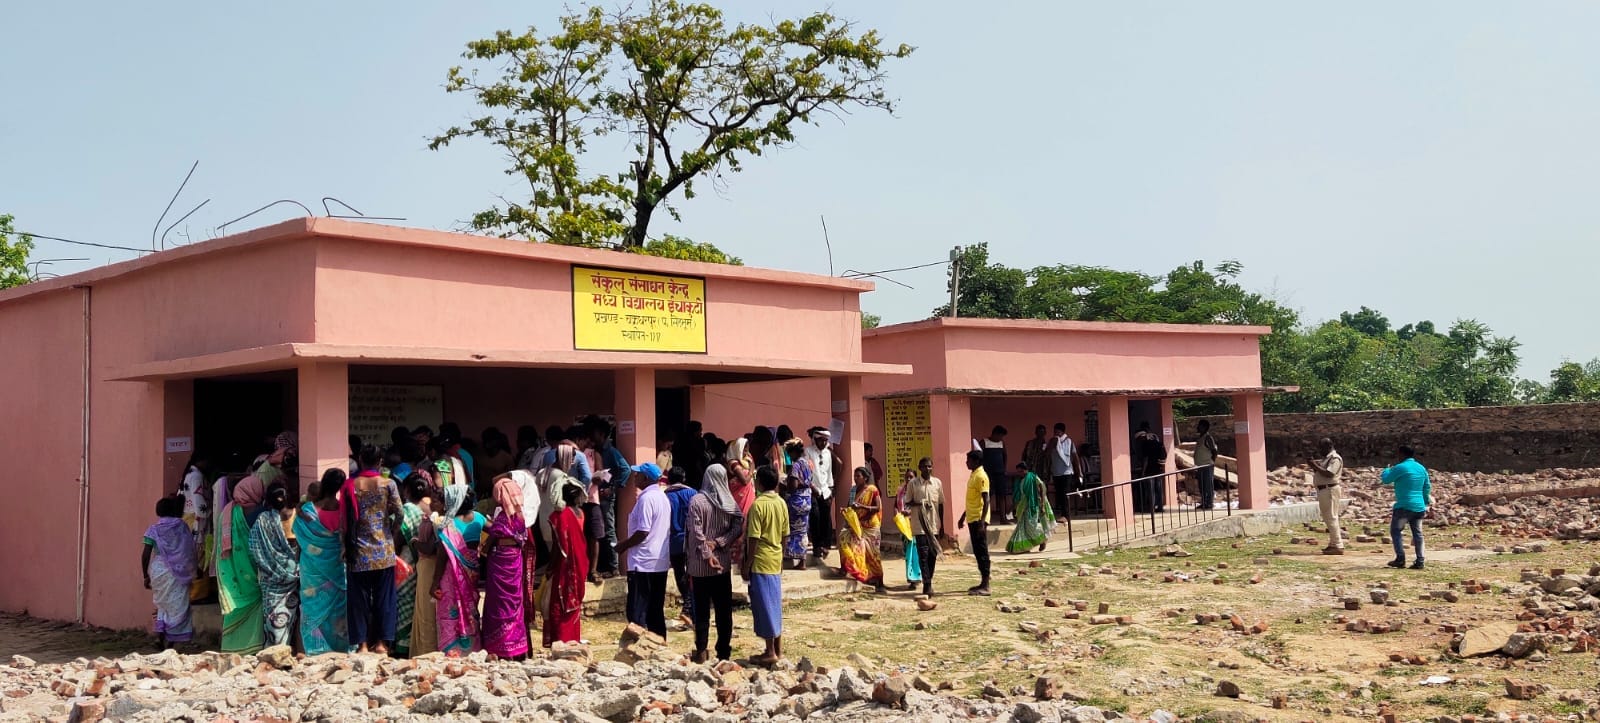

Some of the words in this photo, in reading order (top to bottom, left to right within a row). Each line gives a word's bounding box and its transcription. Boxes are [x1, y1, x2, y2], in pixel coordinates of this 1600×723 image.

[667, 279, 689, 298] केन्द्र
[592, 293, 617, 307] मध्य
[622, 291, 665, 311] विद्यालय
